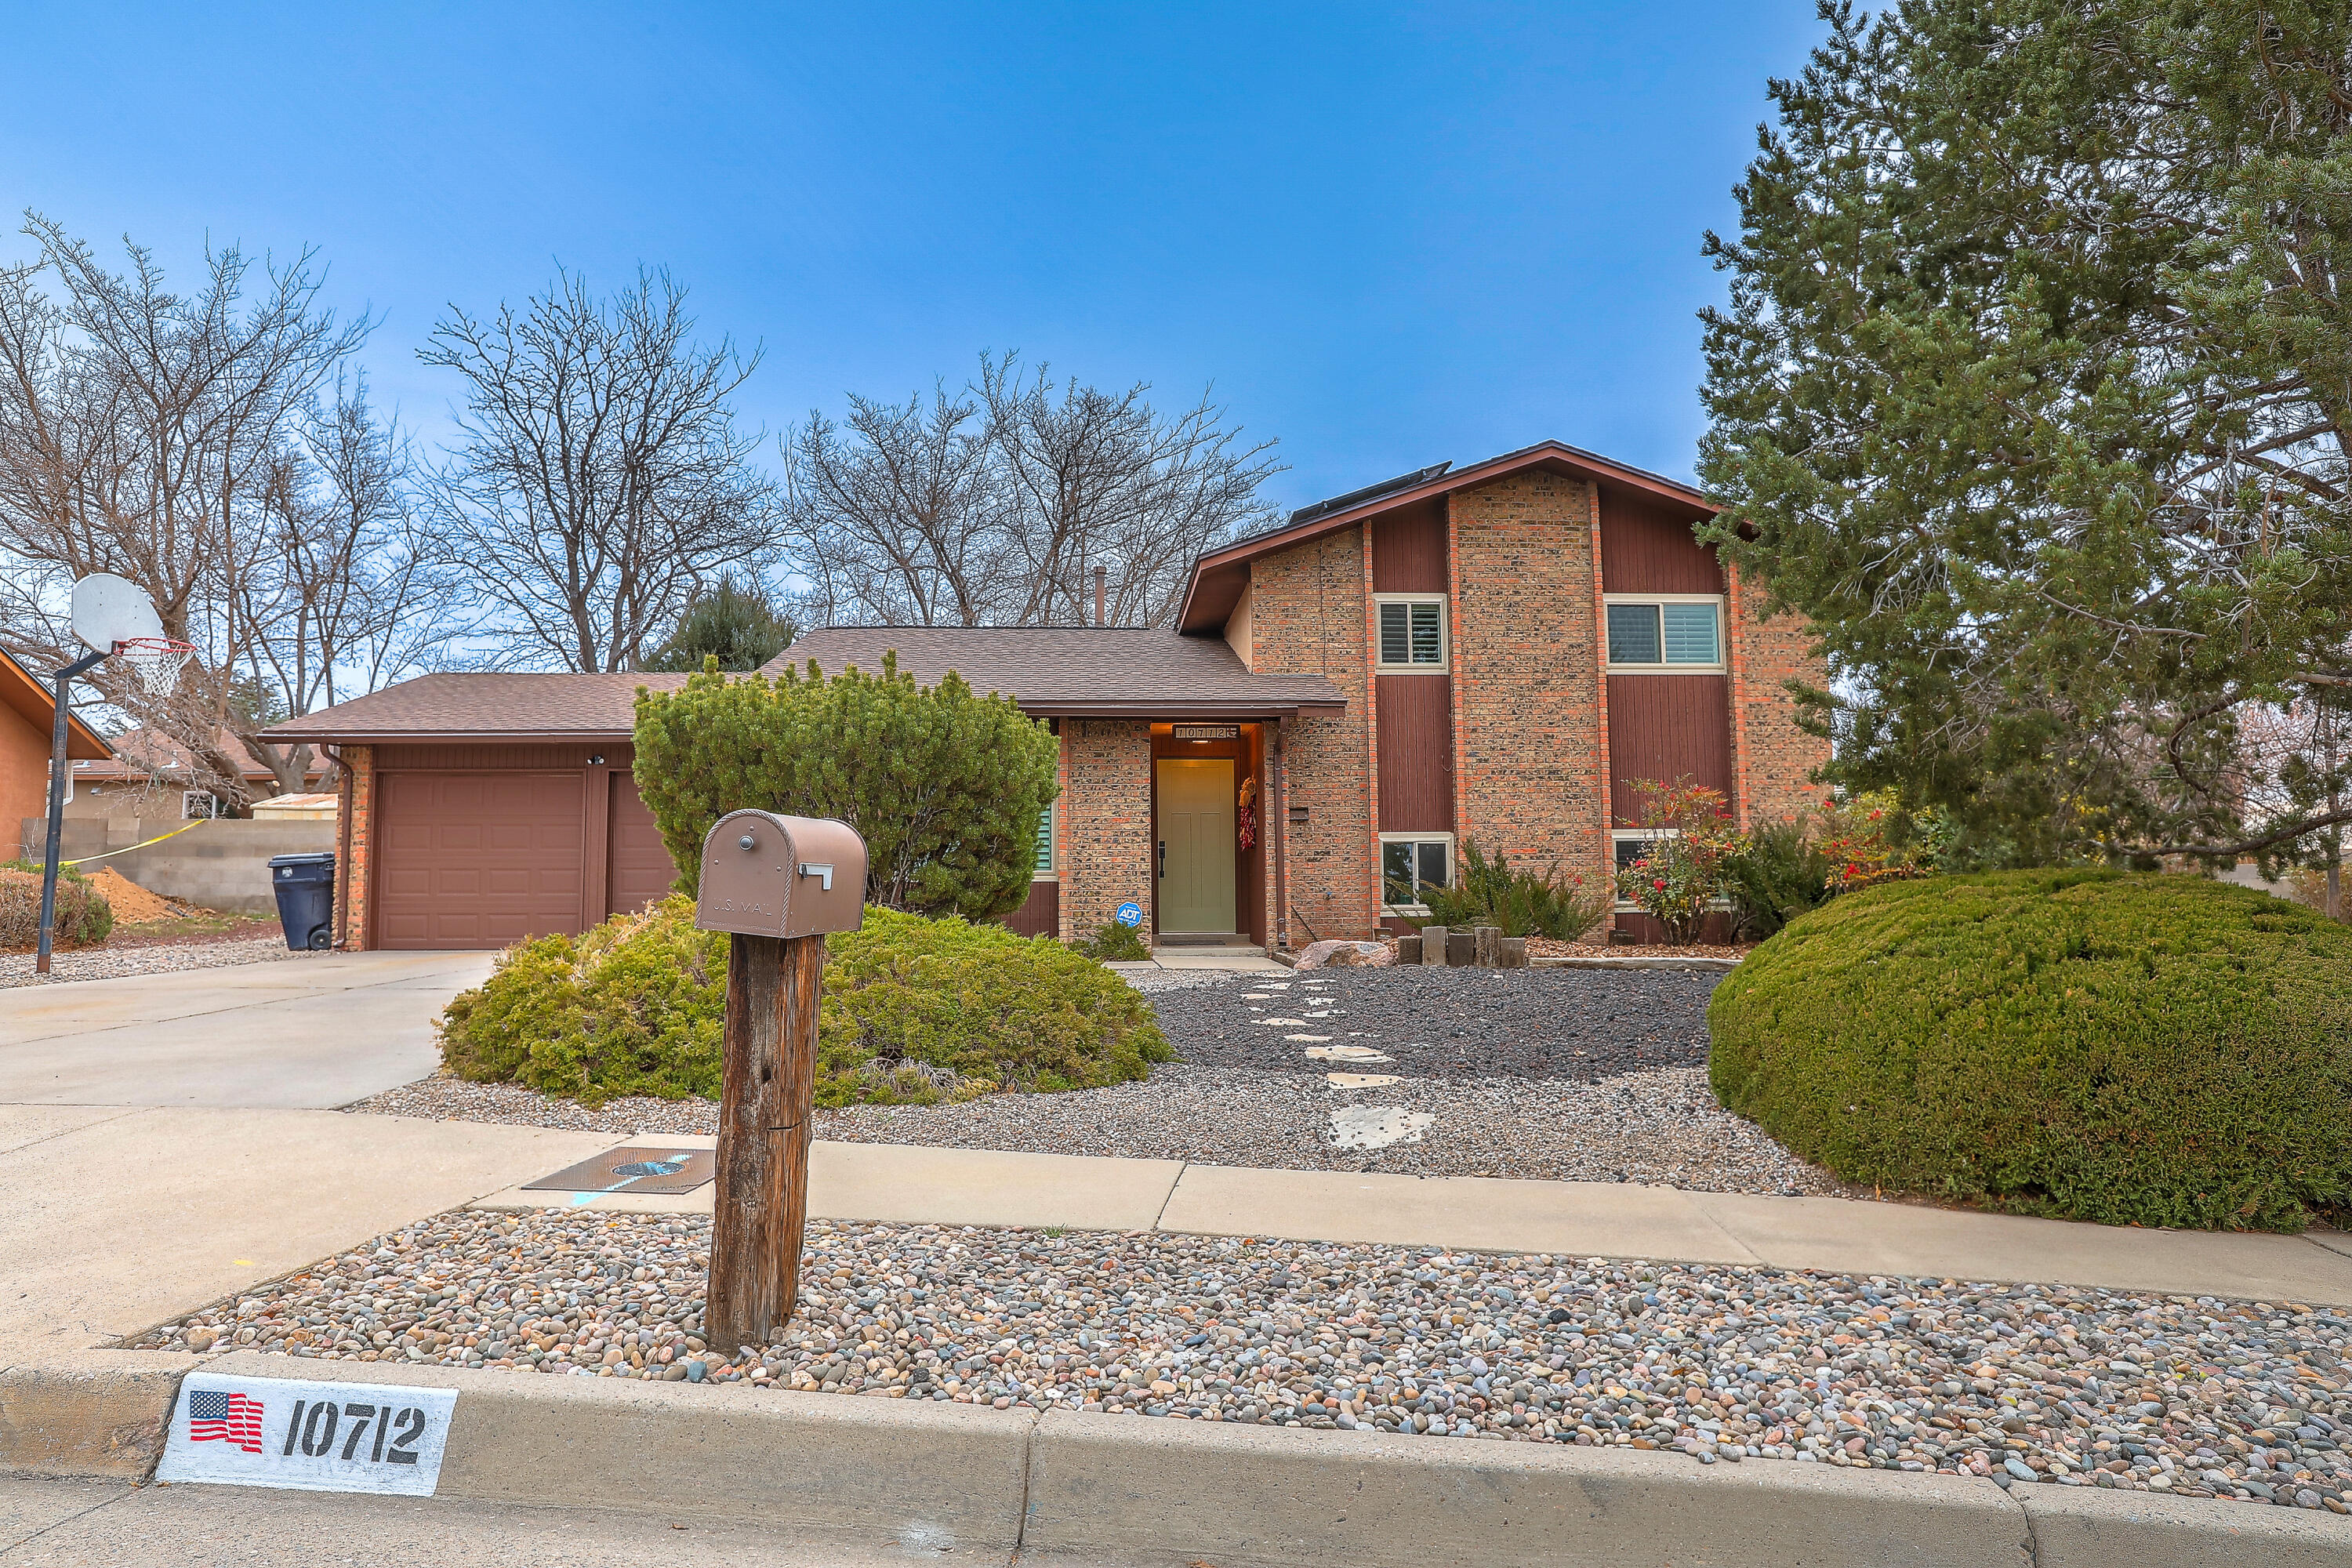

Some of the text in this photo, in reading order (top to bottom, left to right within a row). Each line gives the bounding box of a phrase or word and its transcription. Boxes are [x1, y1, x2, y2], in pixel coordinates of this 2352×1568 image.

[1178, 728, 1224, 738] 10712
[739, 901, 771, 916] MAL
[1119, 909, 1140, 920] ADT
[283, 1399, 426, 1465] 10712
